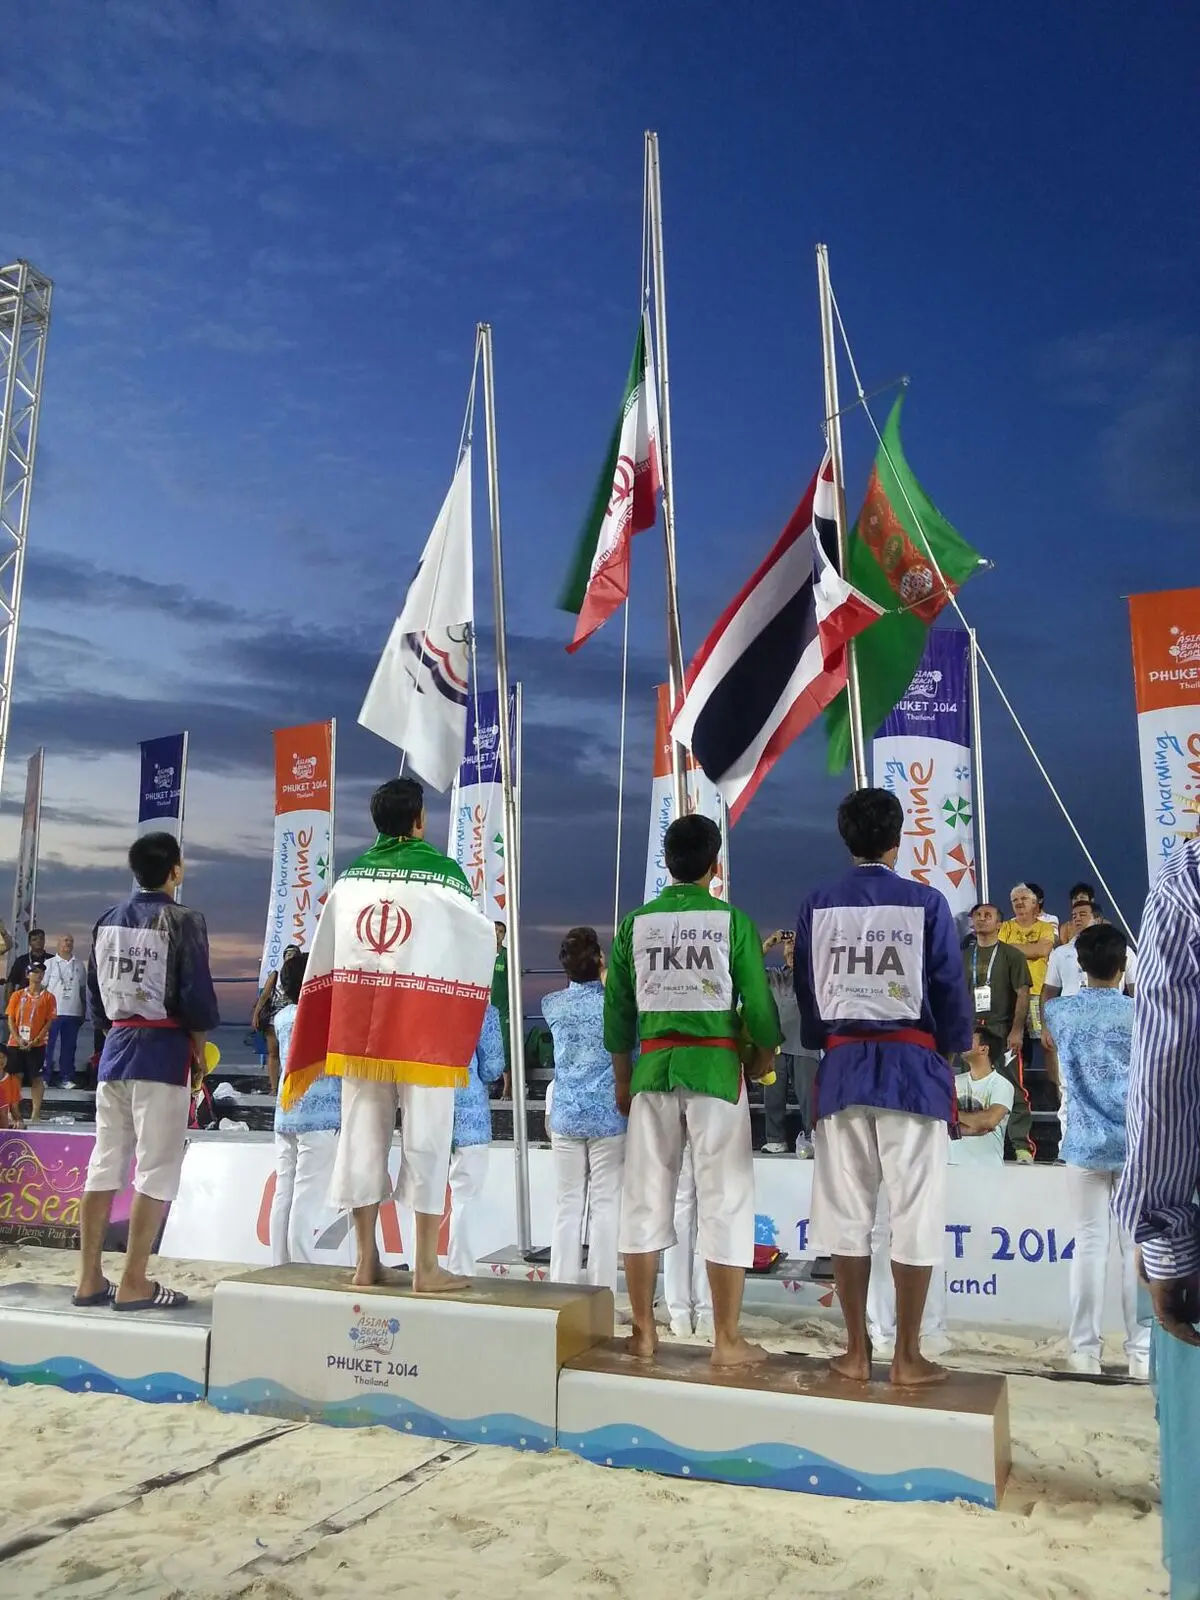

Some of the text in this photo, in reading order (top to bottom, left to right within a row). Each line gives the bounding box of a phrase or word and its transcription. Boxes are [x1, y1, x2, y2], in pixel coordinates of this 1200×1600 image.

[1149, 668, 1200, 682] PHUKE
[934, 702, 957, 713] 2014
[906, 713, 936, 721] Thailand
[1154, 730, 1184, 826] Charming
[282, 783, 310, 792] PHUKET
[145, 791, 168, 800] PHUKET
[278, 828, 297, 897] Charming
[291, 826, 313, 948] unshine
[681, 929, 697, 940] 66
[702, 929, 722, 942] Kg
[866, 930, 885, 942] 66
[891, 930, 913, 945] Kg
[144, 947, 158, 960] Kg
[646, 945, 714, 971] TKM
[830, 946, 905, 976] THA
[109, 956, 146, 983] TPE
[17, 1225, 44, 1238] Theme
[48, 1228, 67, 1240] Park
[358, 1316, 389, 1328] ASIAN
[360, 1326, 388, 1337] BEACH
[358, 1336, 389, 1346] GAMES
[327, 1355, 418, 1377] PHUKET 2014
[354, 1375, 389, 1387] Thailand
